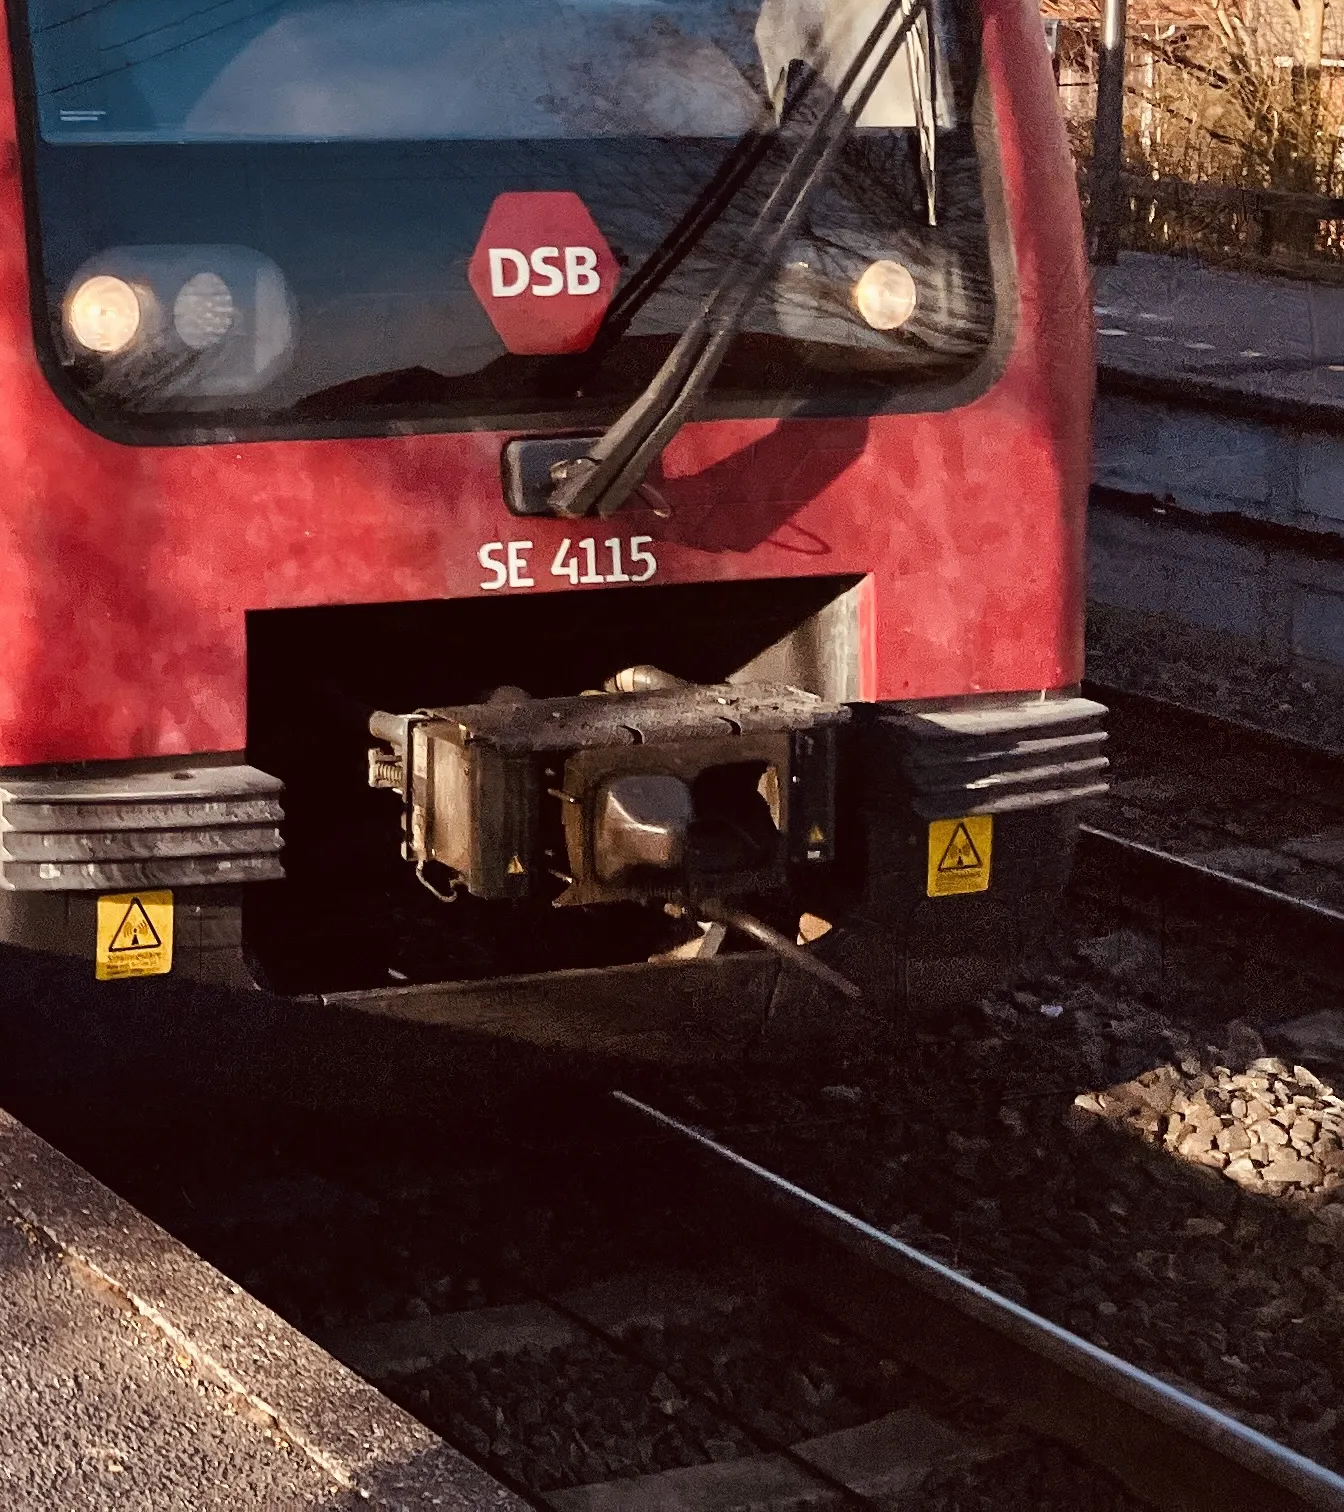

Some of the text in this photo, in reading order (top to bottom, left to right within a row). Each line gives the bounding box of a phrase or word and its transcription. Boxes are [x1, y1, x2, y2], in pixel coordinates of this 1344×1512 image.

[488, 246, 602, 298] DSB
[477, 535, 658, 590] SE 4115
